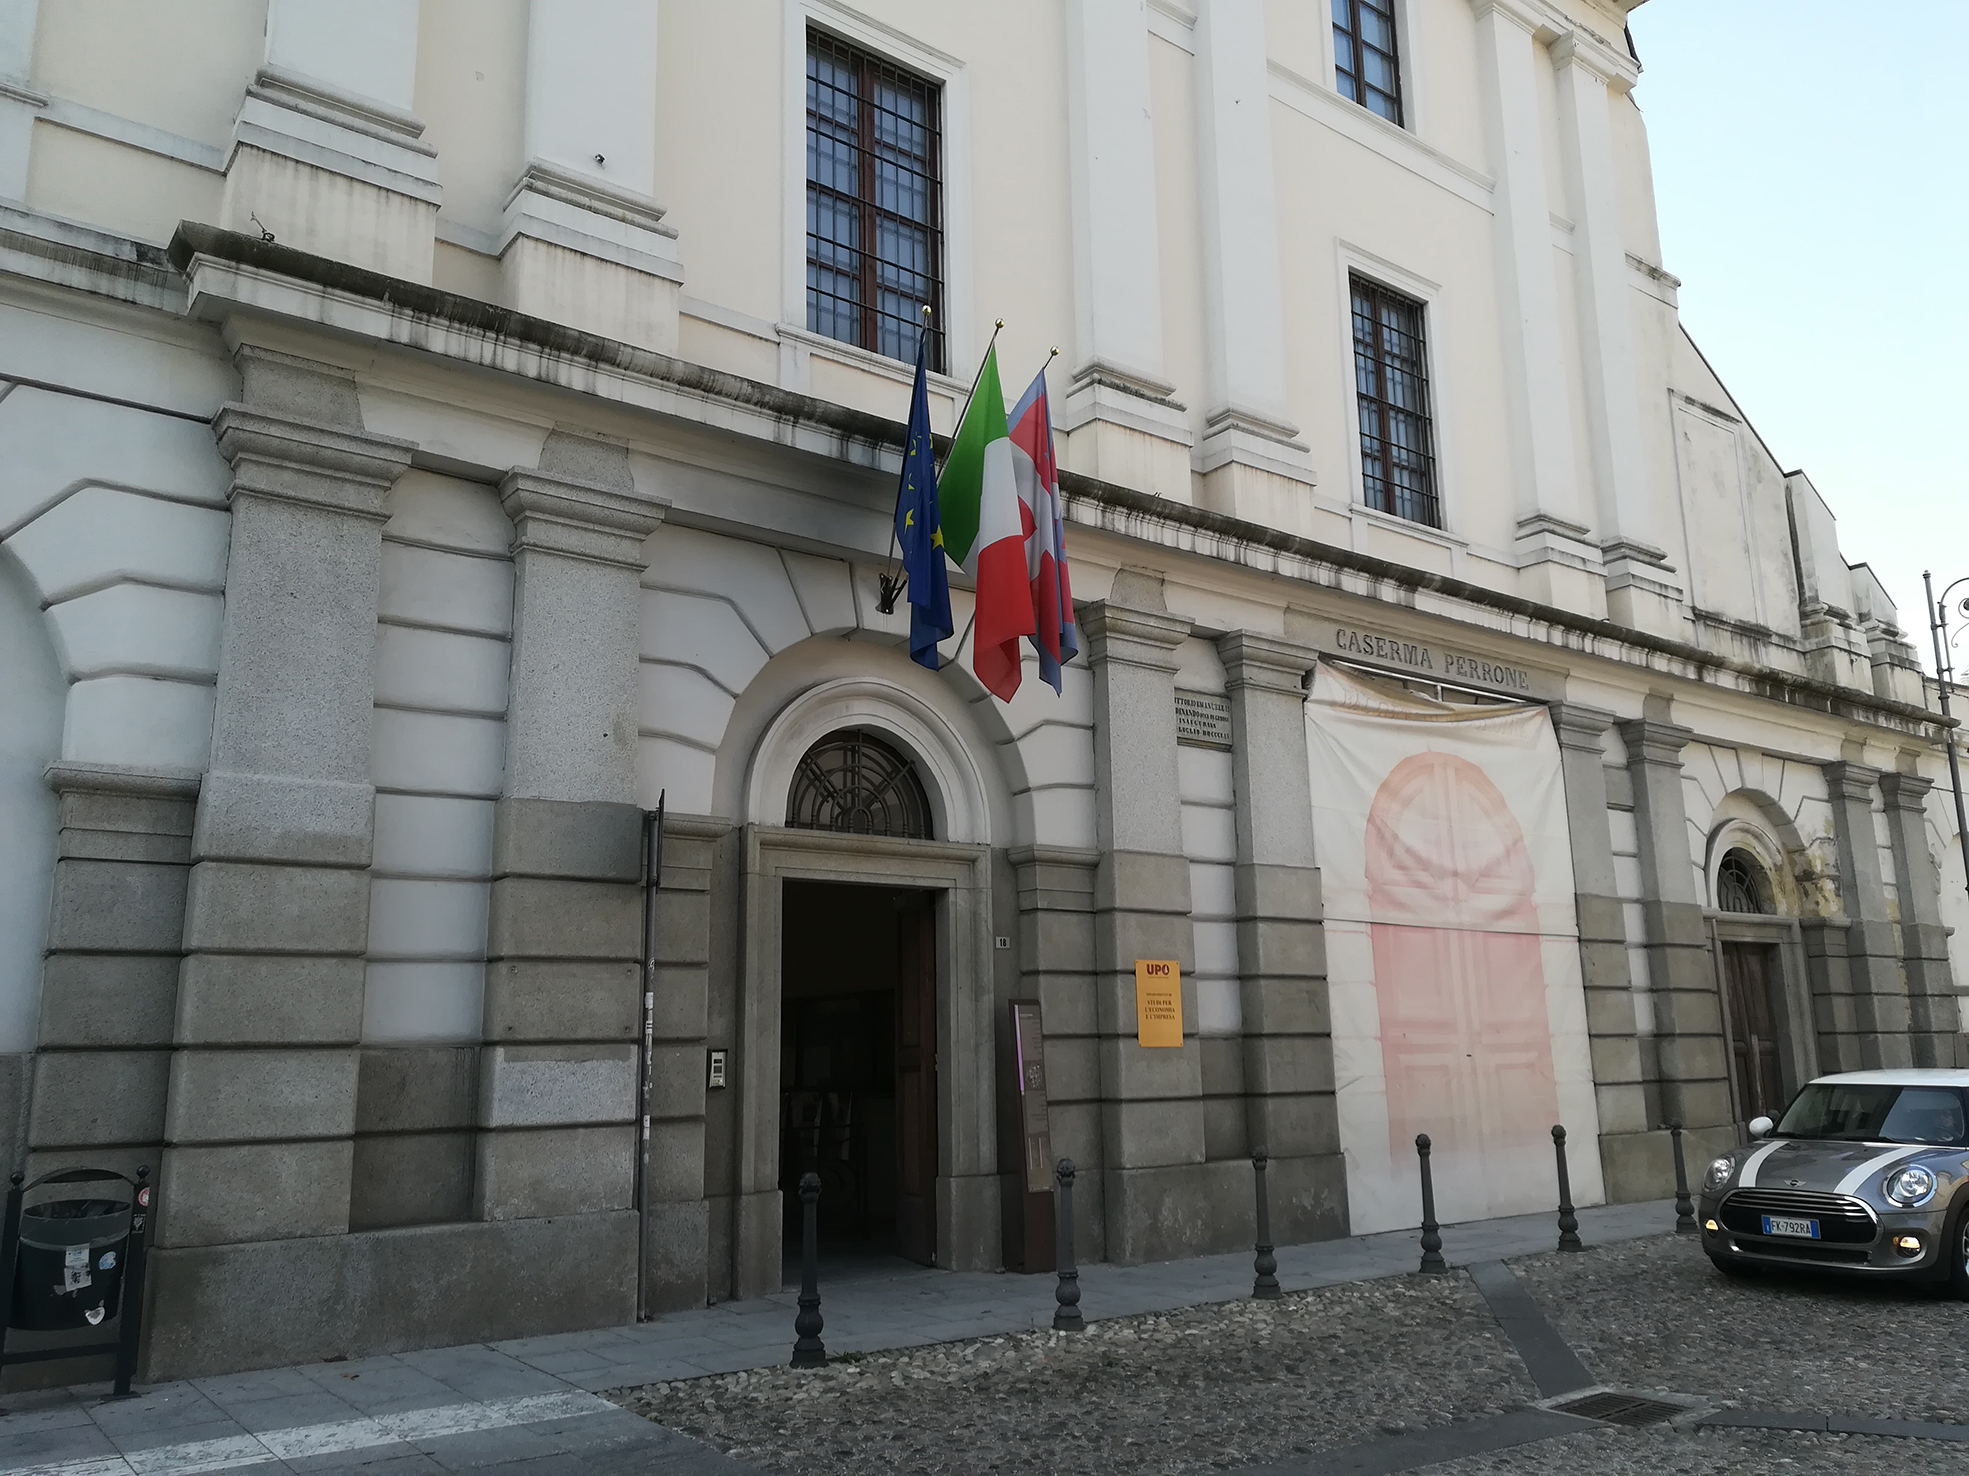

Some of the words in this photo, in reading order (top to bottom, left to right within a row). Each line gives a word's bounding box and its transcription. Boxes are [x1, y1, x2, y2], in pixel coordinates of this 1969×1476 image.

[1336, 628, 1433, 670] CASERMA
[1444, 652, 1530, 691] PERRONE
[999, 938, 1007, 947] 18
[1146, 964, 1170, 976] UPO
